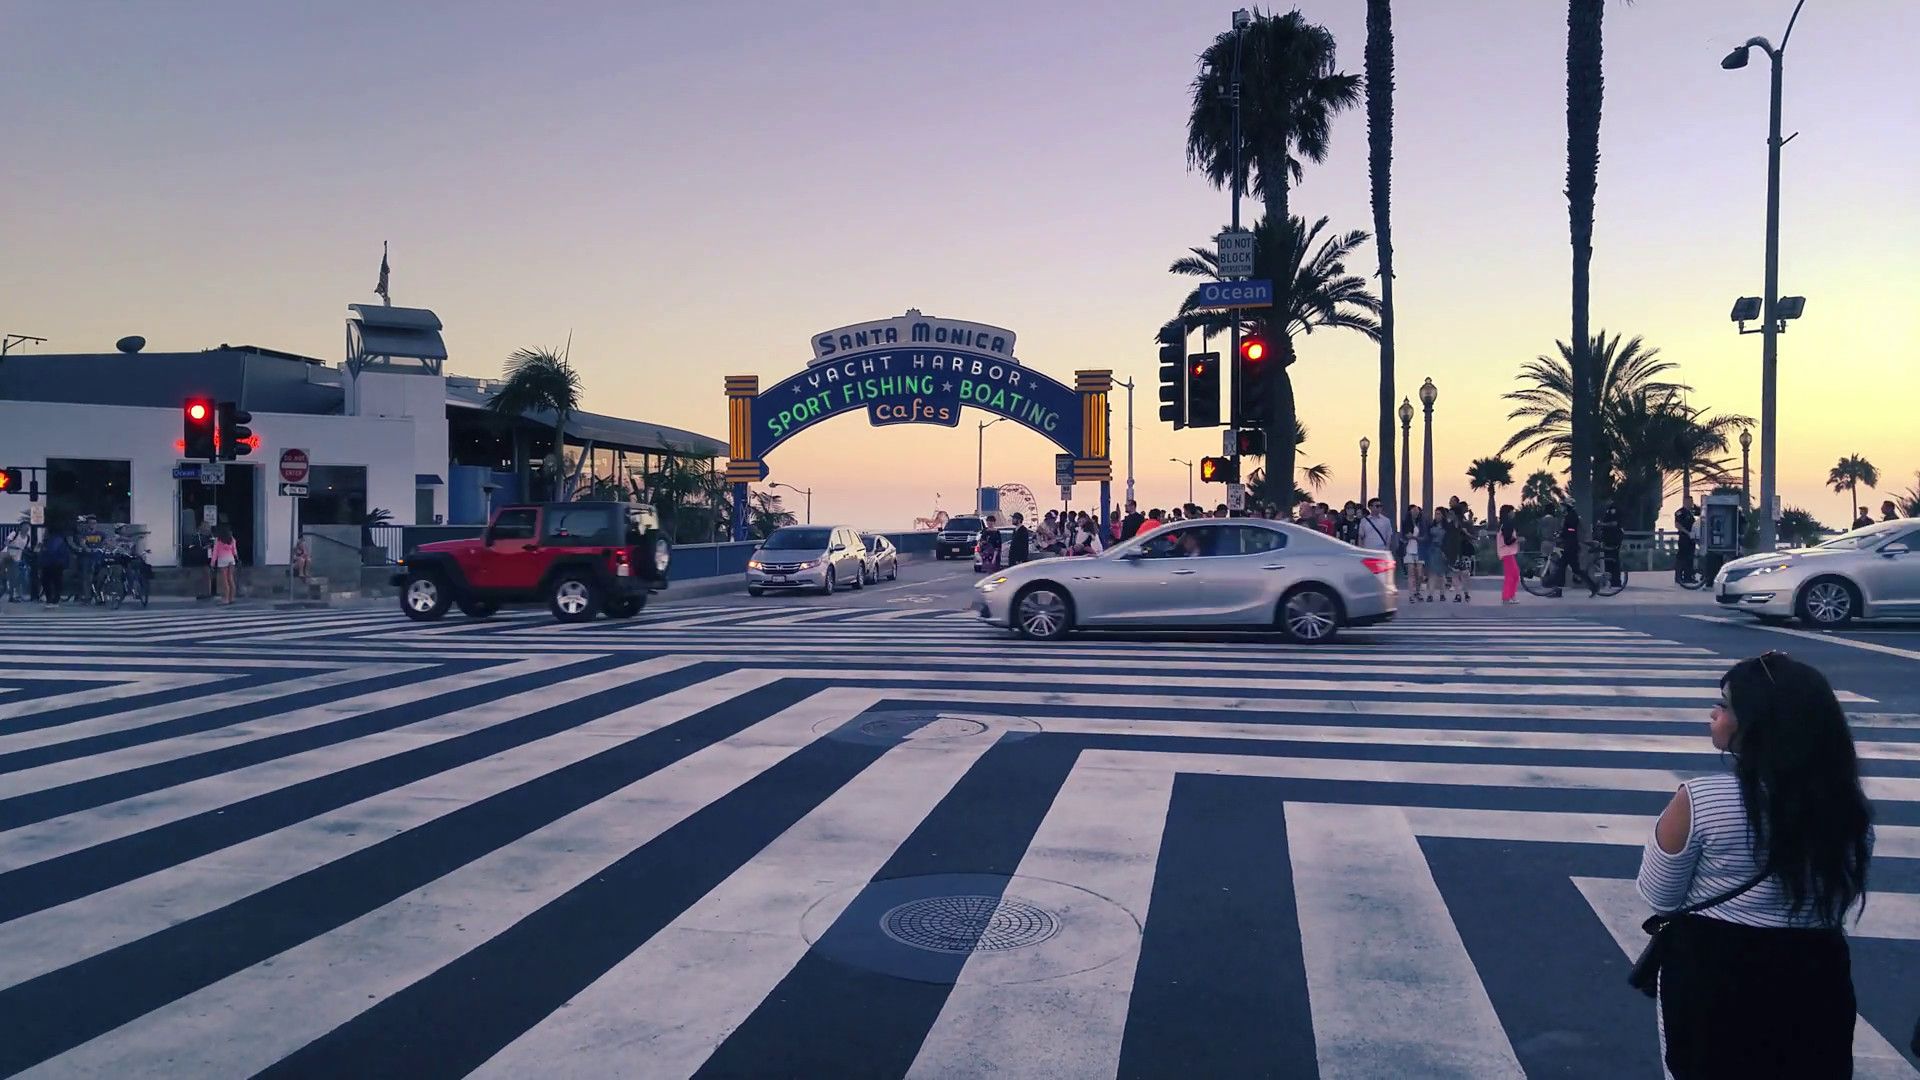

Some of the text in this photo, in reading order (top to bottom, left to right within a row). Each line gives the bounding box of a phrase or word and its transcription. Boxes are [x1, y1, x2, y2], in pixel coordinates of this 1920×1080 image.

[1220, 237, 1251, 249] DO NOT
[1220, 252, 1251, 264] BLOCK
[1205, 285, 1267, 300] Ocean
[818, 322, 1005, 357] SANTA MONICA
[807, 354, 1021, 388] YACHT HARBOR
[767, 375, 1060, 437] SPORT FISHING BOATING
